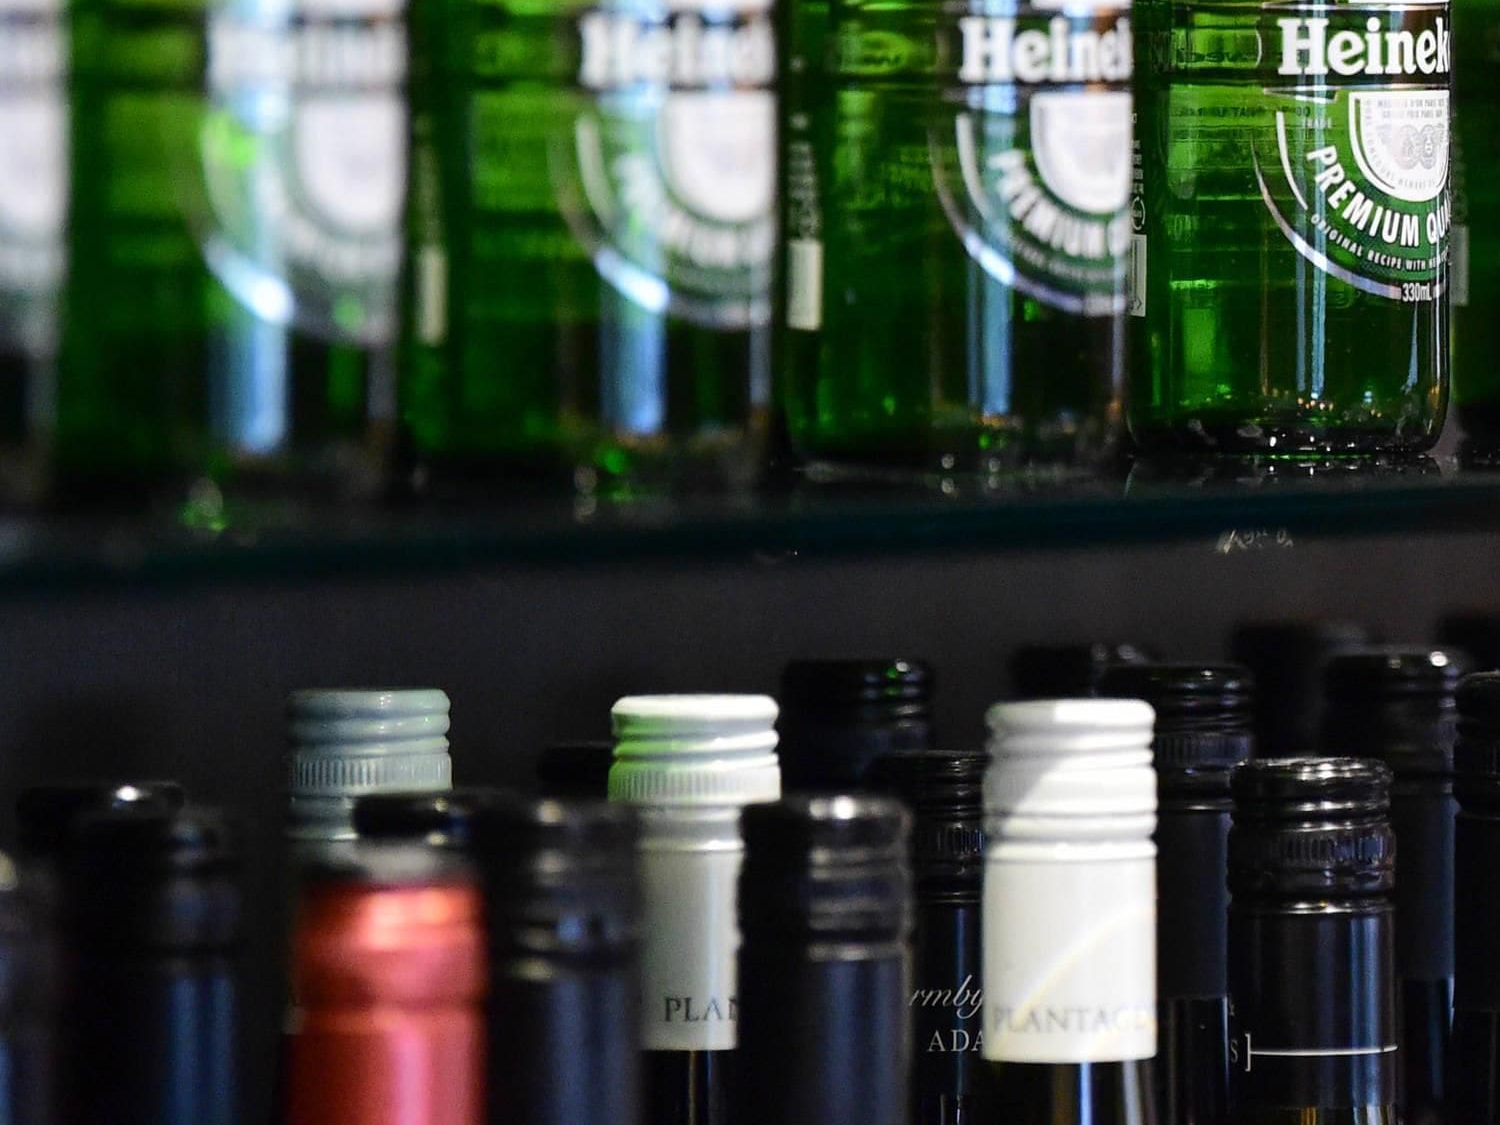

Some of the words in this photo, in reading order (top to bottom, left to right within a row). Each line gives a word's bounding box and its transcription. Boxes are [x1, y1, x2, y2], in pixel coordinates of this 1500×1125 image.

[1306, 145, 1419, 247] PREMIUM
[1311, 213, 1362, 257] ORIGINAL
[1367, 249, 1402, 270] RECIPE
[1405, 259, 1426, 271] WITH
[1402, 282, 1433, 302] 330mL
